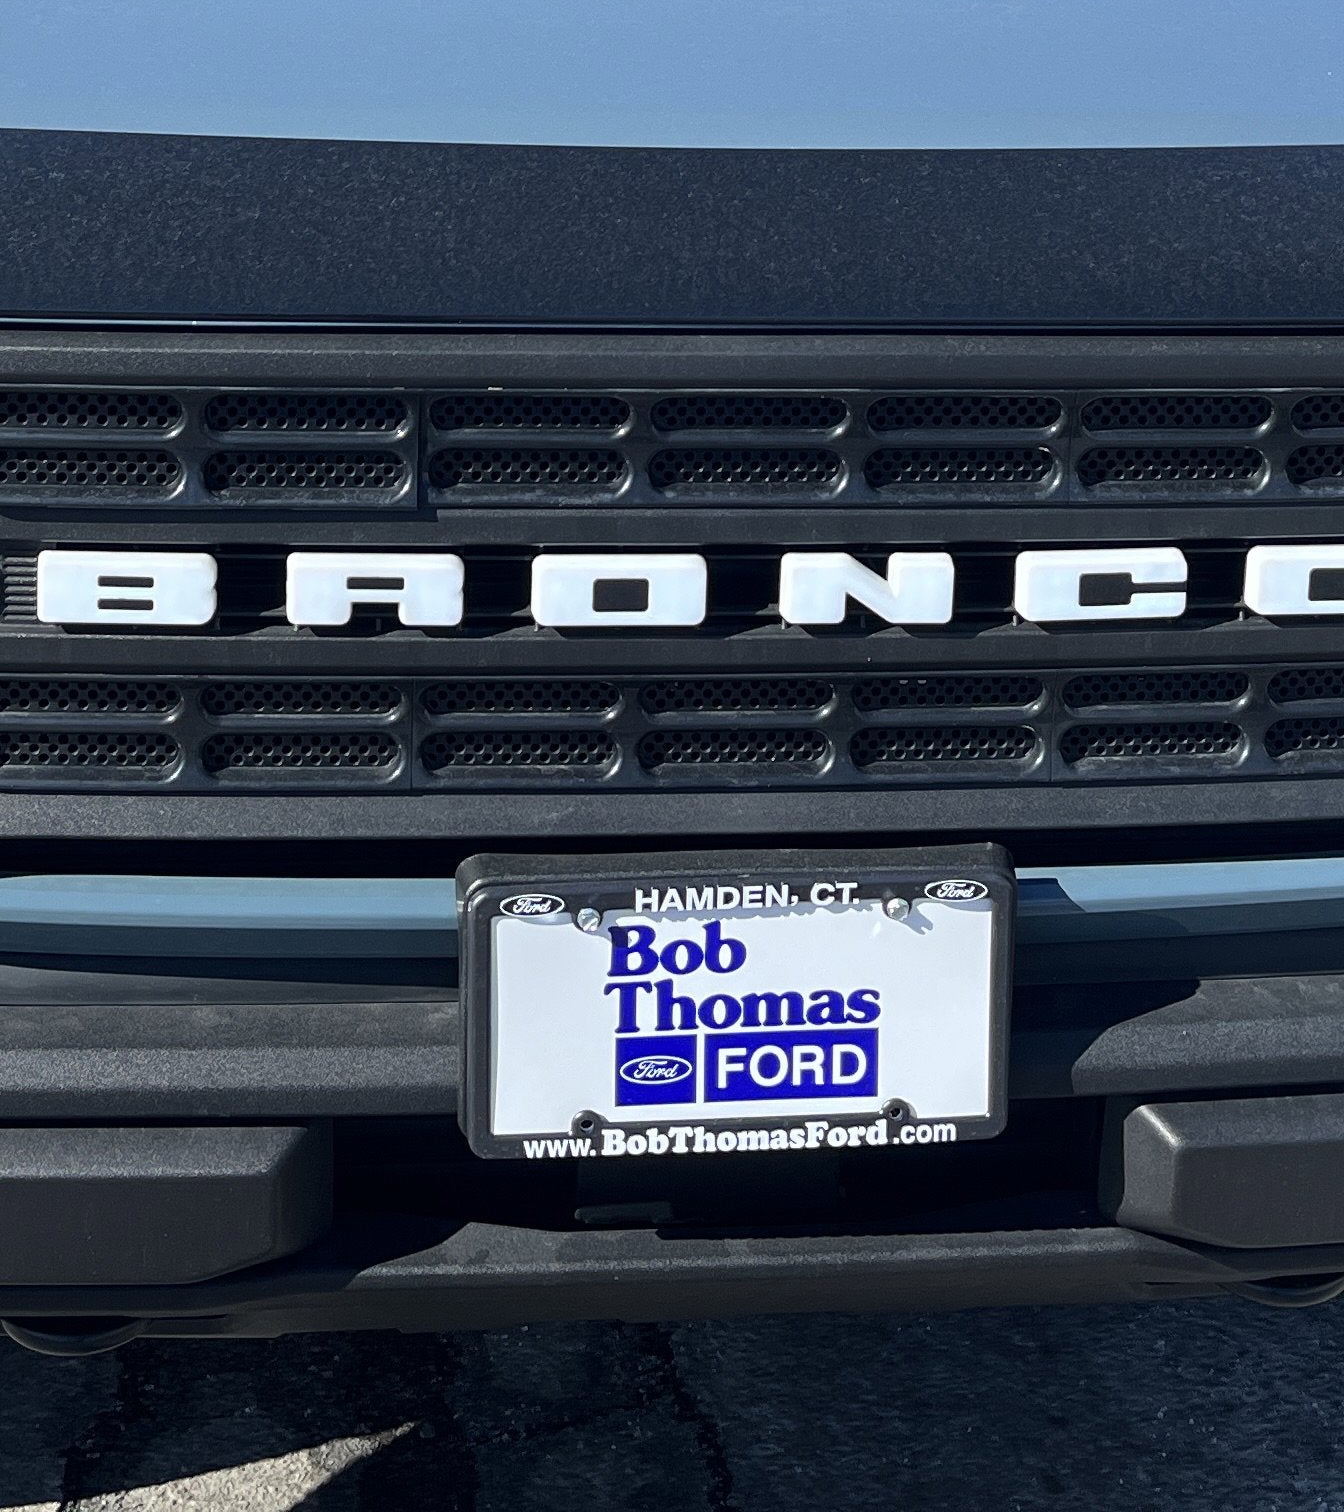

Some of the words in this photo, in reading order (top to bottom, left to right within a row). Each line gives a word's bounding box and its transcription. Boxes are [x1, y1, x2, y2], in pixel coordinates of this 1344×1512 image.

[634, 883, 799, 914] HAMDEN,
[810, 882, 860, 906] CT.
[606, 919, 747, 977] Bob
[603, 978, 882, 1034] Thomas
[716, 1042, 868, 1090] FORD
[522, 1118, 957, 1159] www.BobThomasFord.com
